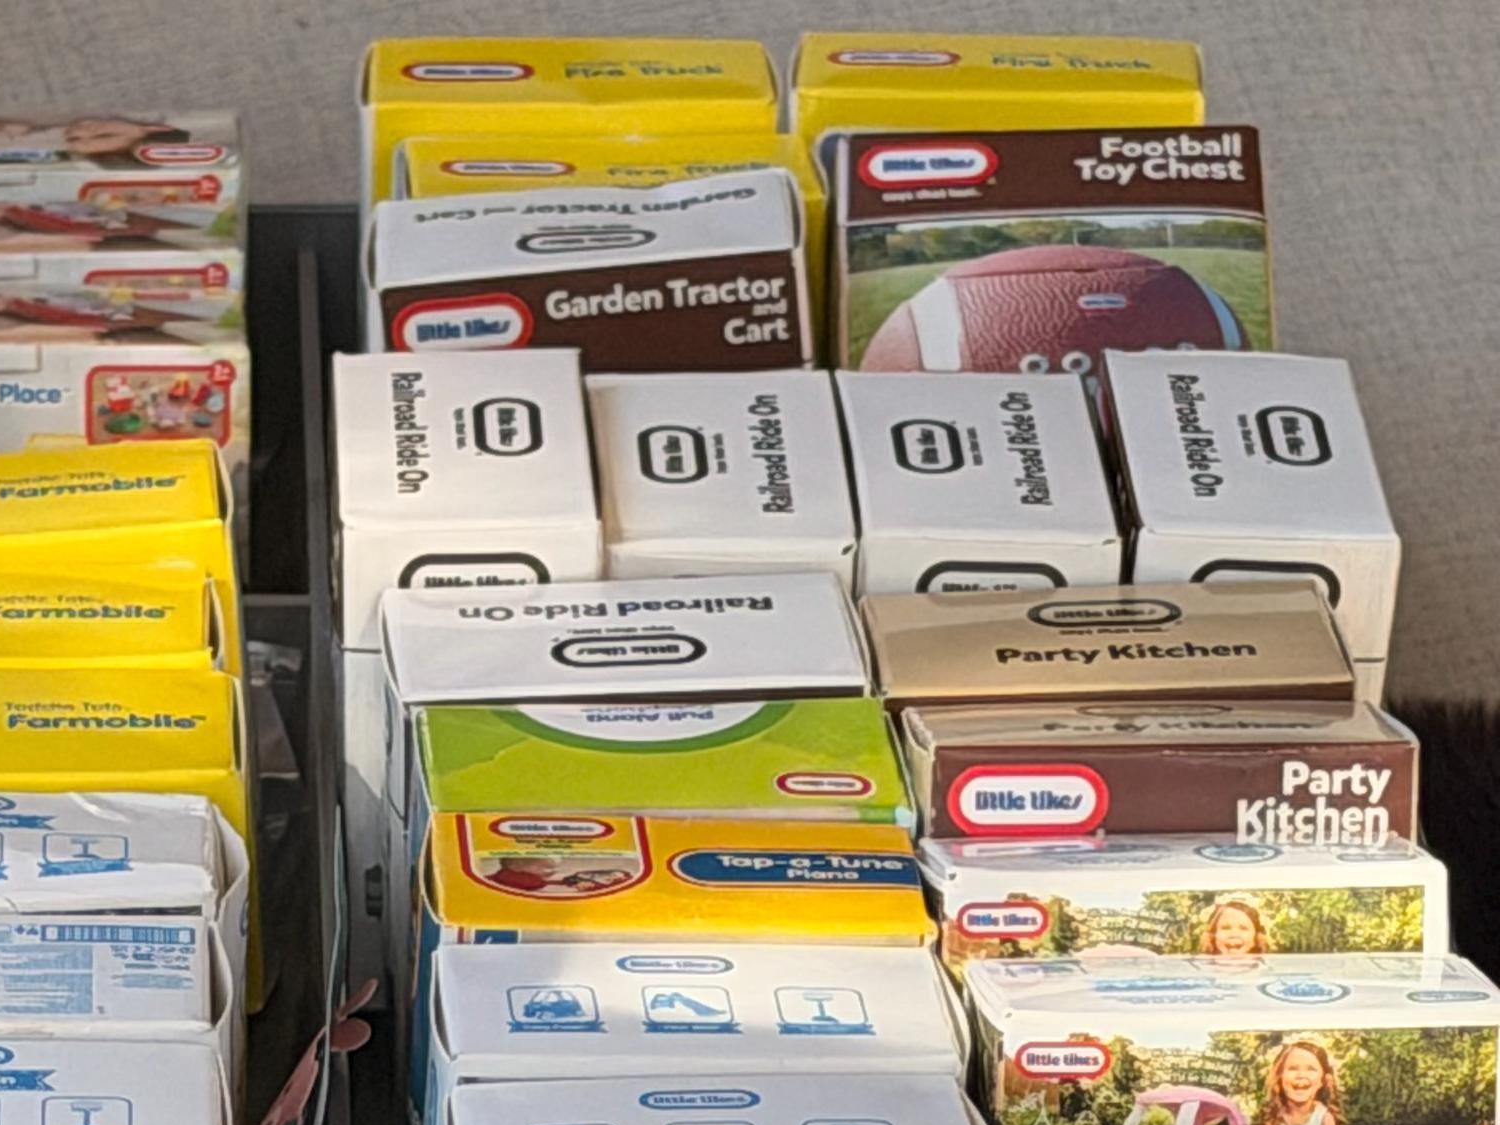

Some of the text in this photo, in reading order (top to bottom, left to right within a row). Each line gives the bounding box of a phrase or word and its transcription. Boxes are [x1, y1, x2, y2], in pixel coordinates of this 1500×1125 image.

[564, 63, 724, 79] Fire Truck
[991, 53, 1151, 70] Fire Truck
[1101, 134, 1242, 158] Football
[882, 157, 977, 172] little tikes
[1073, 156, 1245, 186] Toy Chest
[521, 198, 638, 217] Tractor
[640, 186, 757, 213] Garden
[414, 209, 476, 223] Cart
[545, 276, 785, 321] Garden Tractor
[752, 300, 788, 316] and
[416, 317, 511, 343] little tikes
[723, 318, 790, 345] Cart
[392, 371, 430, 494] Railroad Ride On
[1167, 373, 1224, 498] Railroad Ride On
[748, 394, 795, 514] Railroad Ride On
[999, 391, 1054, 506] Railroad Ride On
[457, 596, 774, 622] Railroad Ride On
[995, 640, 1258, 665] Party Kitchen
[7, 714, 197, 730] Farmobile
[1043, 721, 1150, 735] Party
[1281, 760, 1392, 804] Party
[974, 790, 1084, 812] little tikes
[1236, 798, 1389, 836] Kitchen
[720, 855, 904, 872] Tap-a-Tune
[786, 868, 860, 881] Piano
[966, 913, 1039, 928] little tikes
[1026, 1053, 1100, 1067] little tikes
